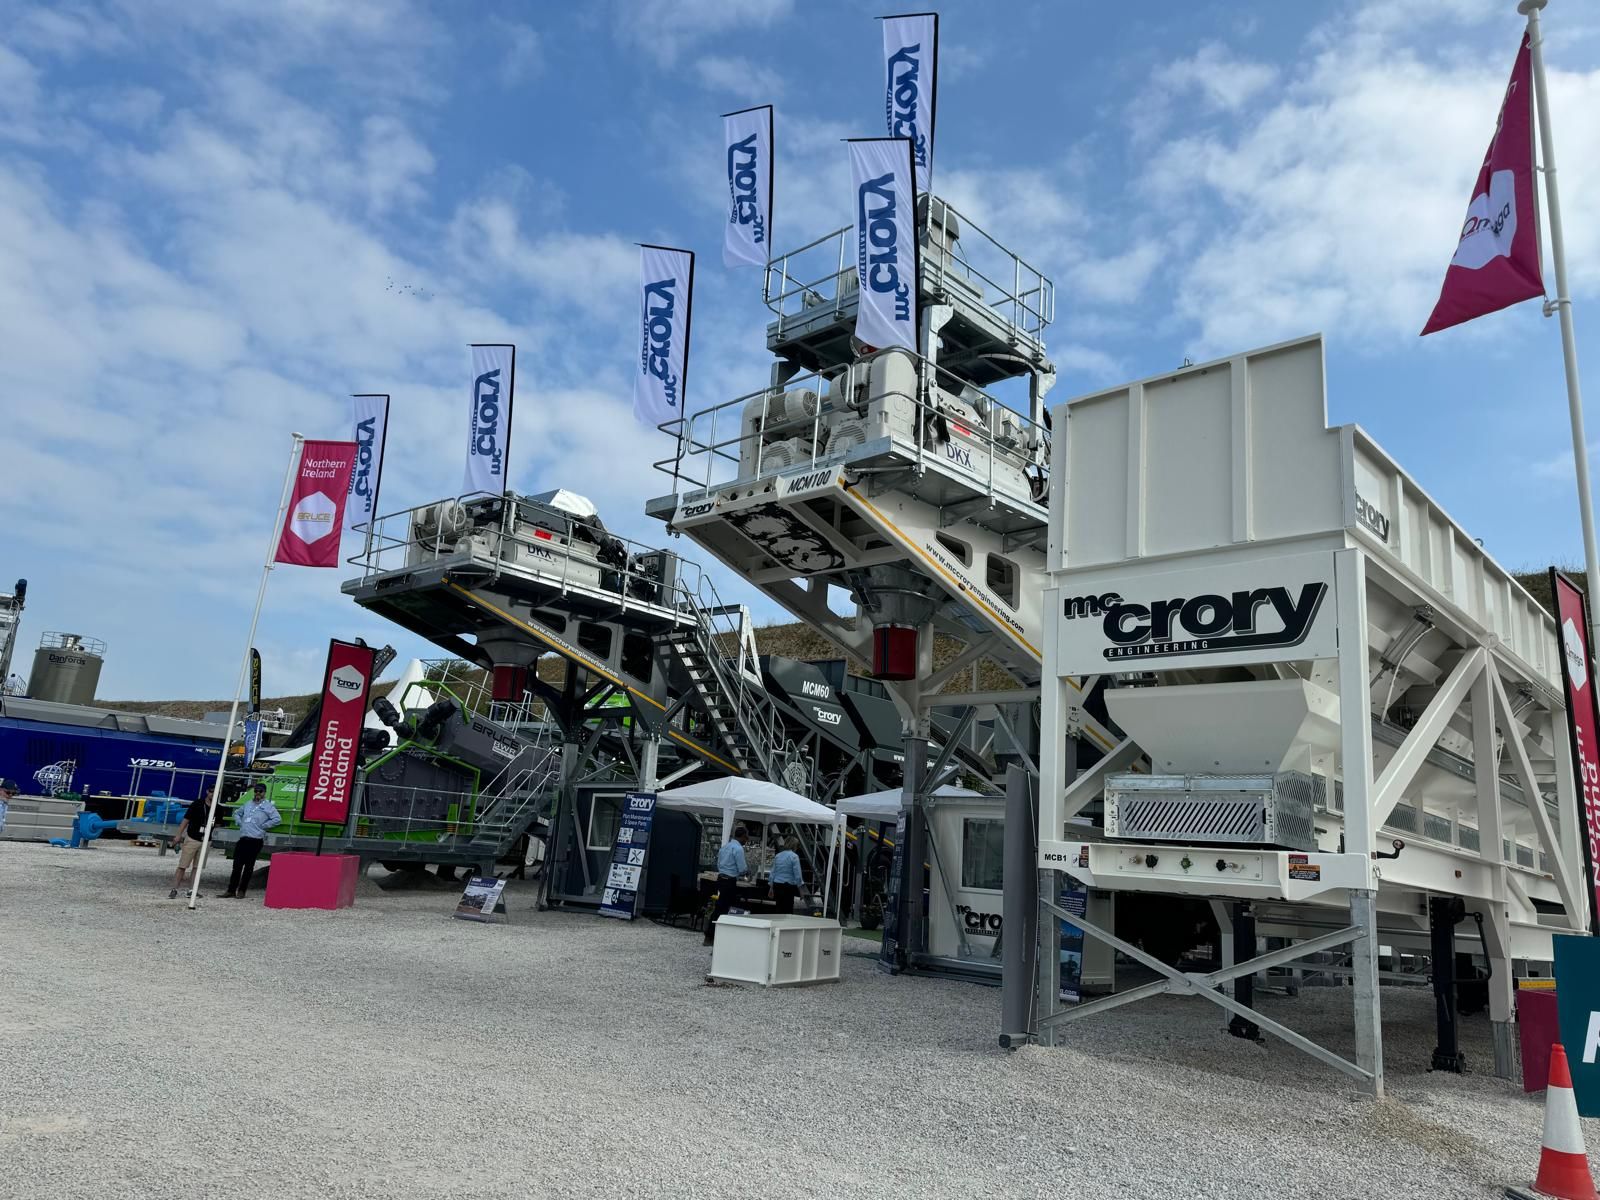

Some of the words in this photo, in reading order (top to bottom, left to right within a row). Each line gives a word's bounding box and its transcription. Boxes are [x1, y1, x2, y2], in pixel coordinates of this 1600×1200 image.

[305, 458, 346, 469] Northern
[946, 442, 972, 469] DKX
[302, 467, 336, 479] Ireland
[787, 470, 832, 494] MCM100
[297, 512, 331, 522] BRUCE
[925, 543, 1025, 634] www.mccroryengineering.com
[527, 620, 619, 679] www.mccroryengineering.com
[1108, 640, 1210, 657] ENGINEERING
[48, 653, 86, 666] Danfords
[802, 680, 830, 699] MCM60
[472, 721, 520, 751] BRUCE
[313, 719, 340, 801] Northern
[328, 737, 353, 803] Ireland
[1044, 853, 1067, 862] MCB1
